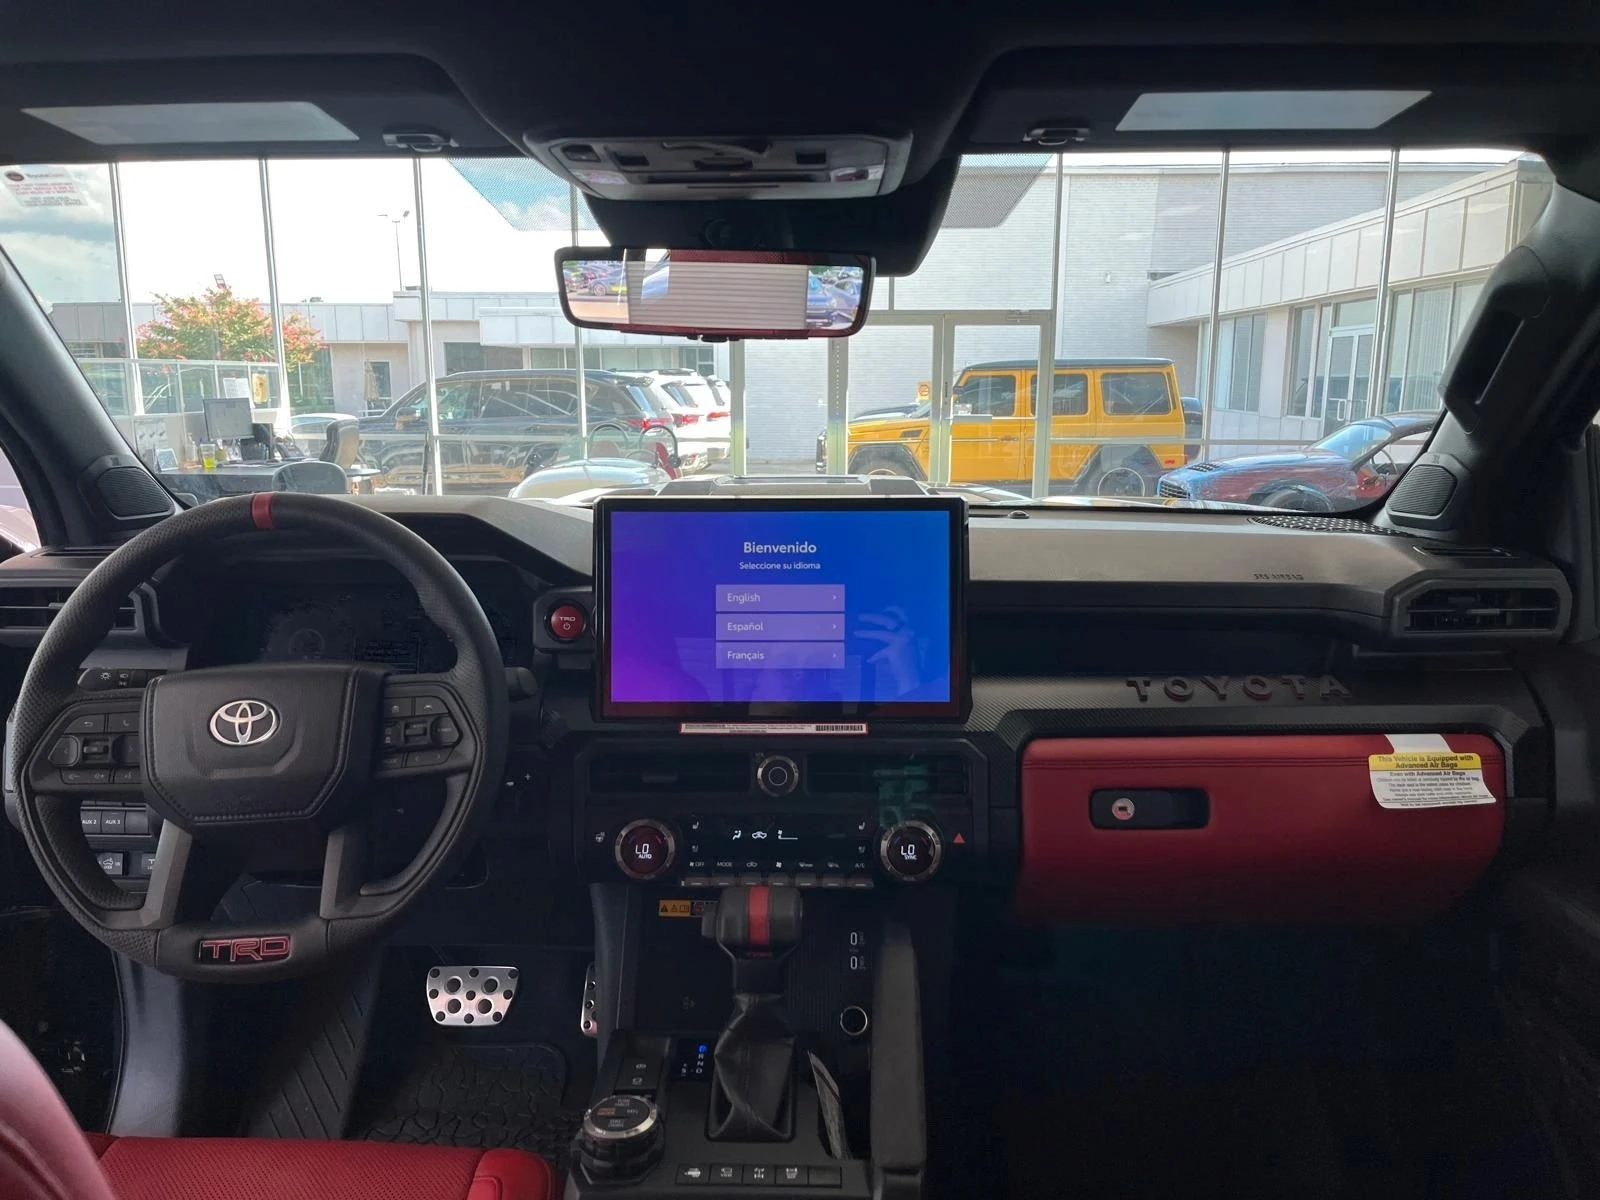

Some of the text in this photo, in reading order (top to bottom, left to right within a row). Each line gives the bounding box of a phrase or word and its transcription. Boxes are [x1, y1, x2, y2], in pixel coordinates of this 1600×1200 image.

[743, 541, 817, 554] Bienvenido
[739, 561, 821, 570] Seleccione su idioma
[727, 592, 761, 604] English
[727, 621, 764, 632] Español
[727, 650, 765, 661] Français
[1126, 674, 1352, 703] TOYOTA
[1427, 755, 1458, 763] Equipped
[1440, 761, 1458, 769] Bags
[635, 843, 650, 854] LO
[900, 844, 916, 856] LO
[202, 936, 290, 962] TRD
